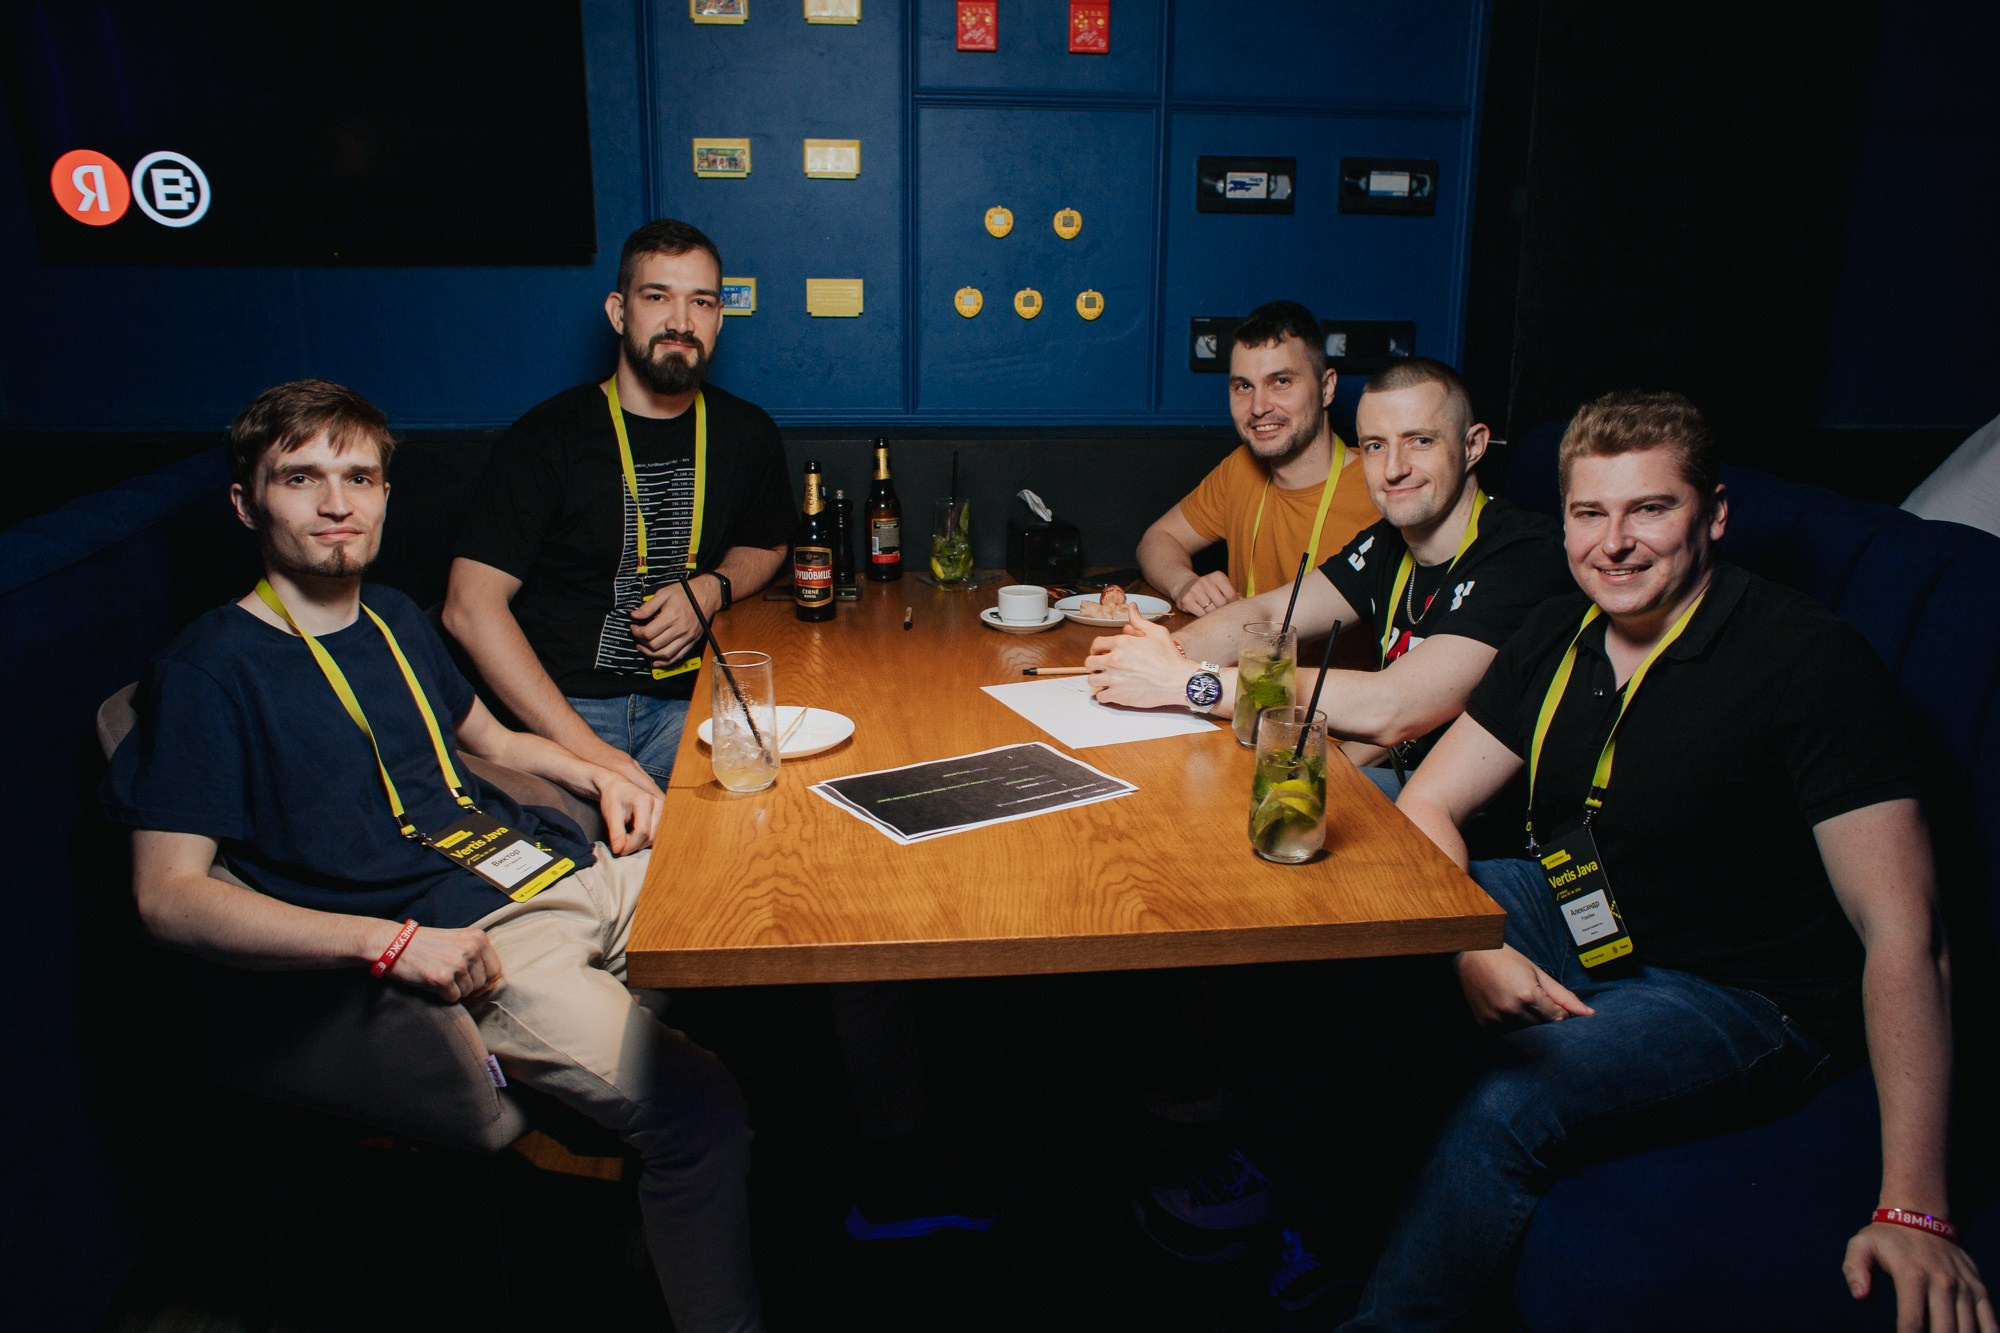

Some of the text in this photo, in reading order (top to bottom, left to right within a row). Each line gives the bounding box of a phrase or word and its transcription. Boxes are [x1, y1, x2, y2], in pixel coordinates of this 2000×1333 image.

[449, 839, 487, 859] Vertis
[481, 827, 510, 842] Java
[491, 849, 521, 867] Виктор
[1548, 860, 1599, 889] Vertis Java
[1570, 900, 1600, 916] Александр
